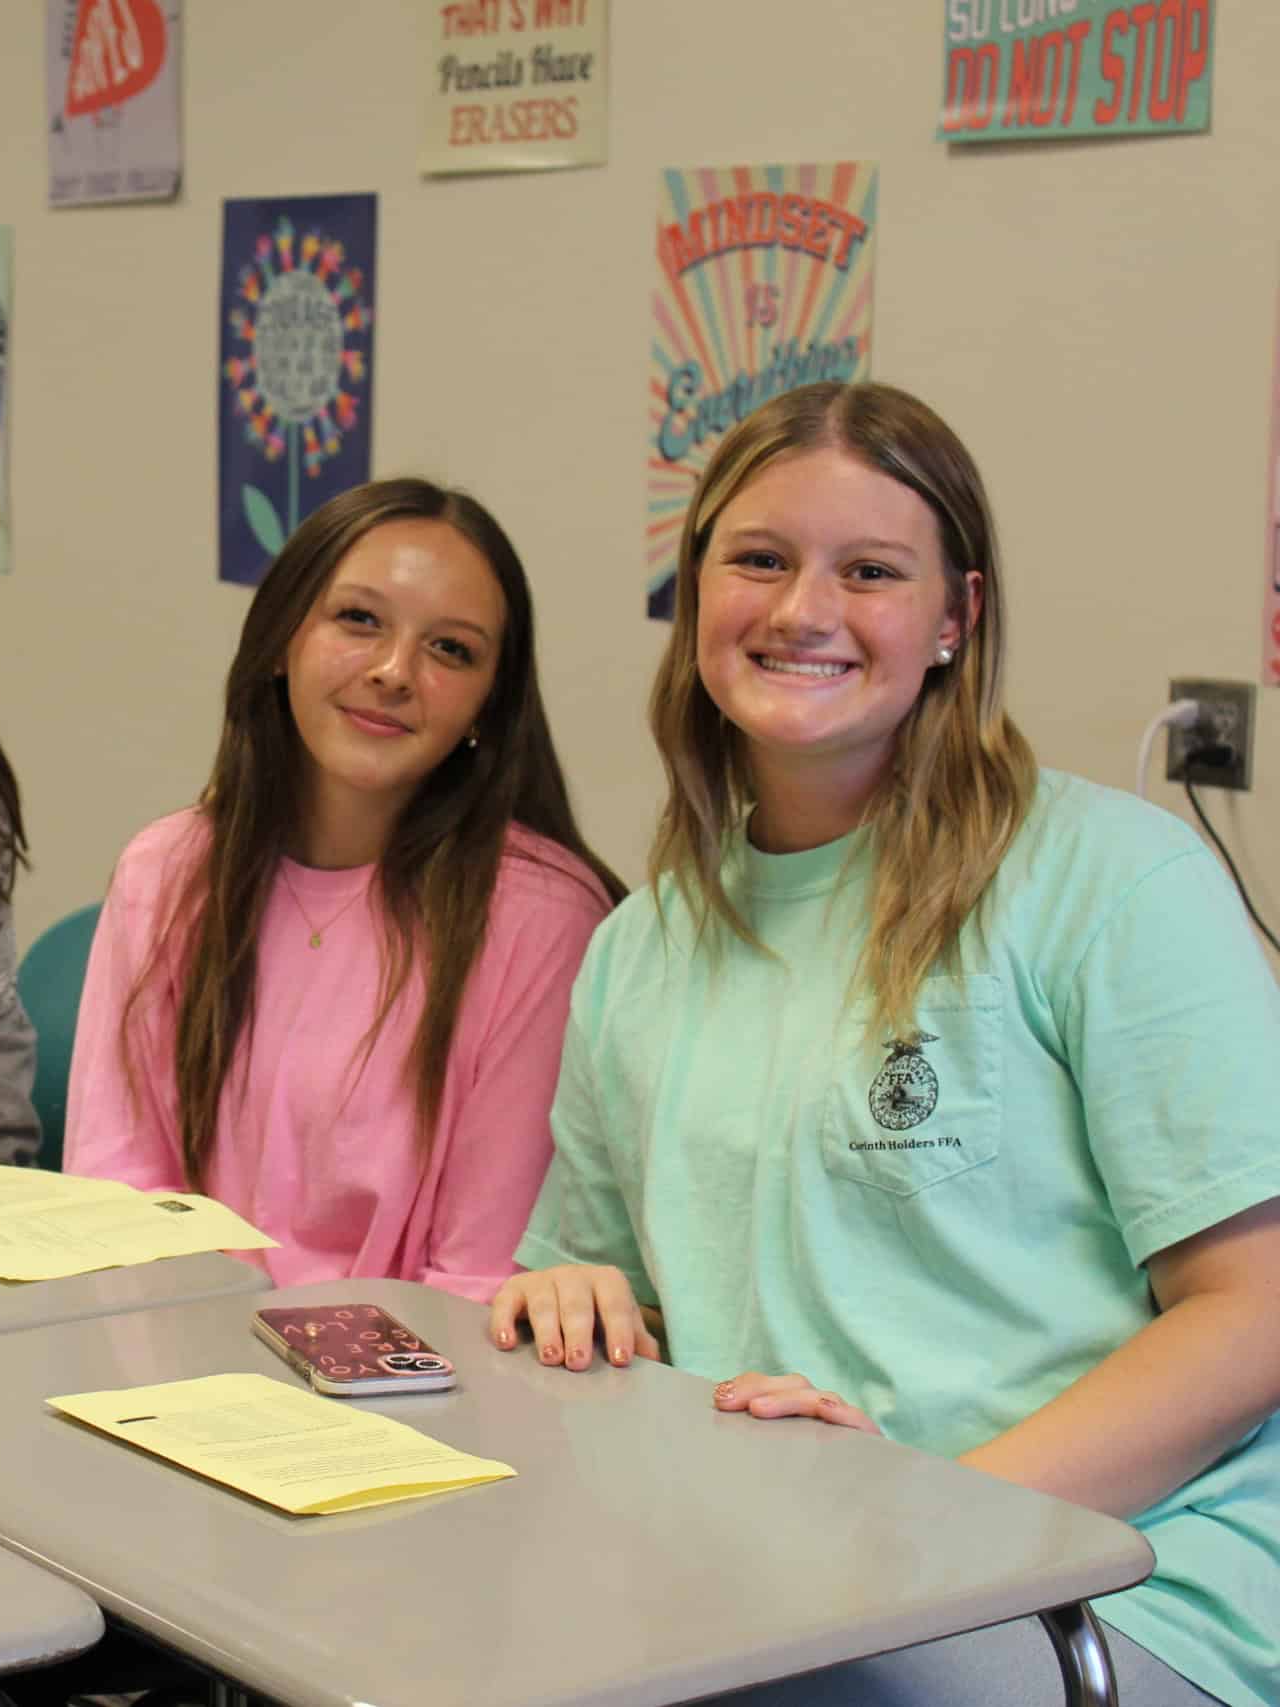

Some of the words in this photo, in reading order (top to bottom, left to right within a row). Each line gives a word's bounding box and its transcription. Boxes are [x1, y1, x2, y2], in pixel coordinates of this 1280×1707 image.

[440, 0, 527, 40] THATS
[438, 52, 524, 94] Pencils
[531, 44, 595, 86] Have
[943, 42, 1001, 132] DO
[1001, 19, 1093, 128] NOT
[1093, 0, 1209, 126] STOP
[448, 97, 578, 146] ERASERS
[656, 191, 866, 274] MINDSET
[745, 284, 779, 328] IS
[889, 1072, 915, 1086] FFA
[849, 1140, 886, 1151] Corinth
[888, 1138, 935, 1150] Holders
[938, 1136, 962, 1148] FFA
